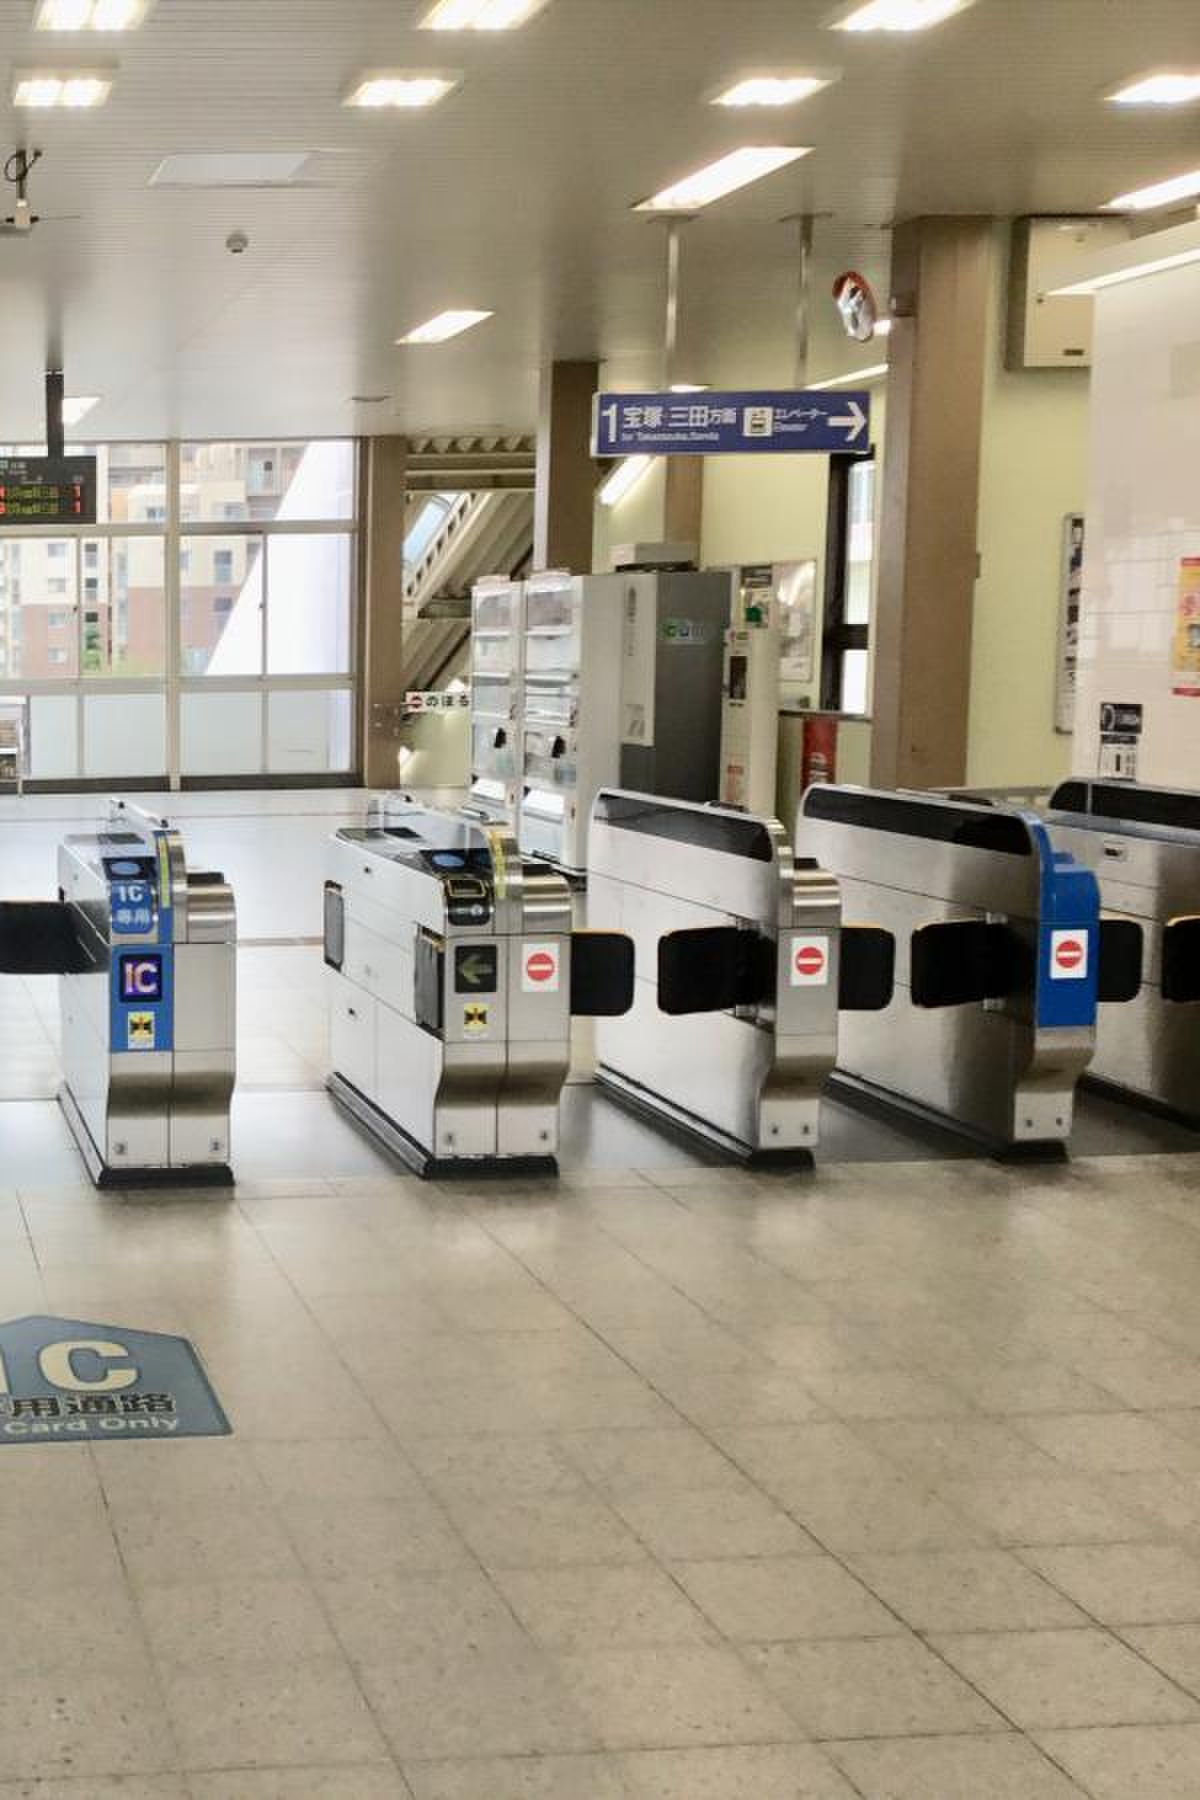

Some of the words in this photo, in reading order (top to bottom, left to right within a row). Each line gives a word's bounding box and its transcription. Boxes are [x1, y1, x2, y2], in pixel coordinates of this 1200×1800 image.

[602, 403, 618, 443] 1
[119, 884, 144, 903] IC
[124, 962, 158, 993] IC
[3, 1418, 88, 1434] Card
[99, 1416, 180, 1433] Only
